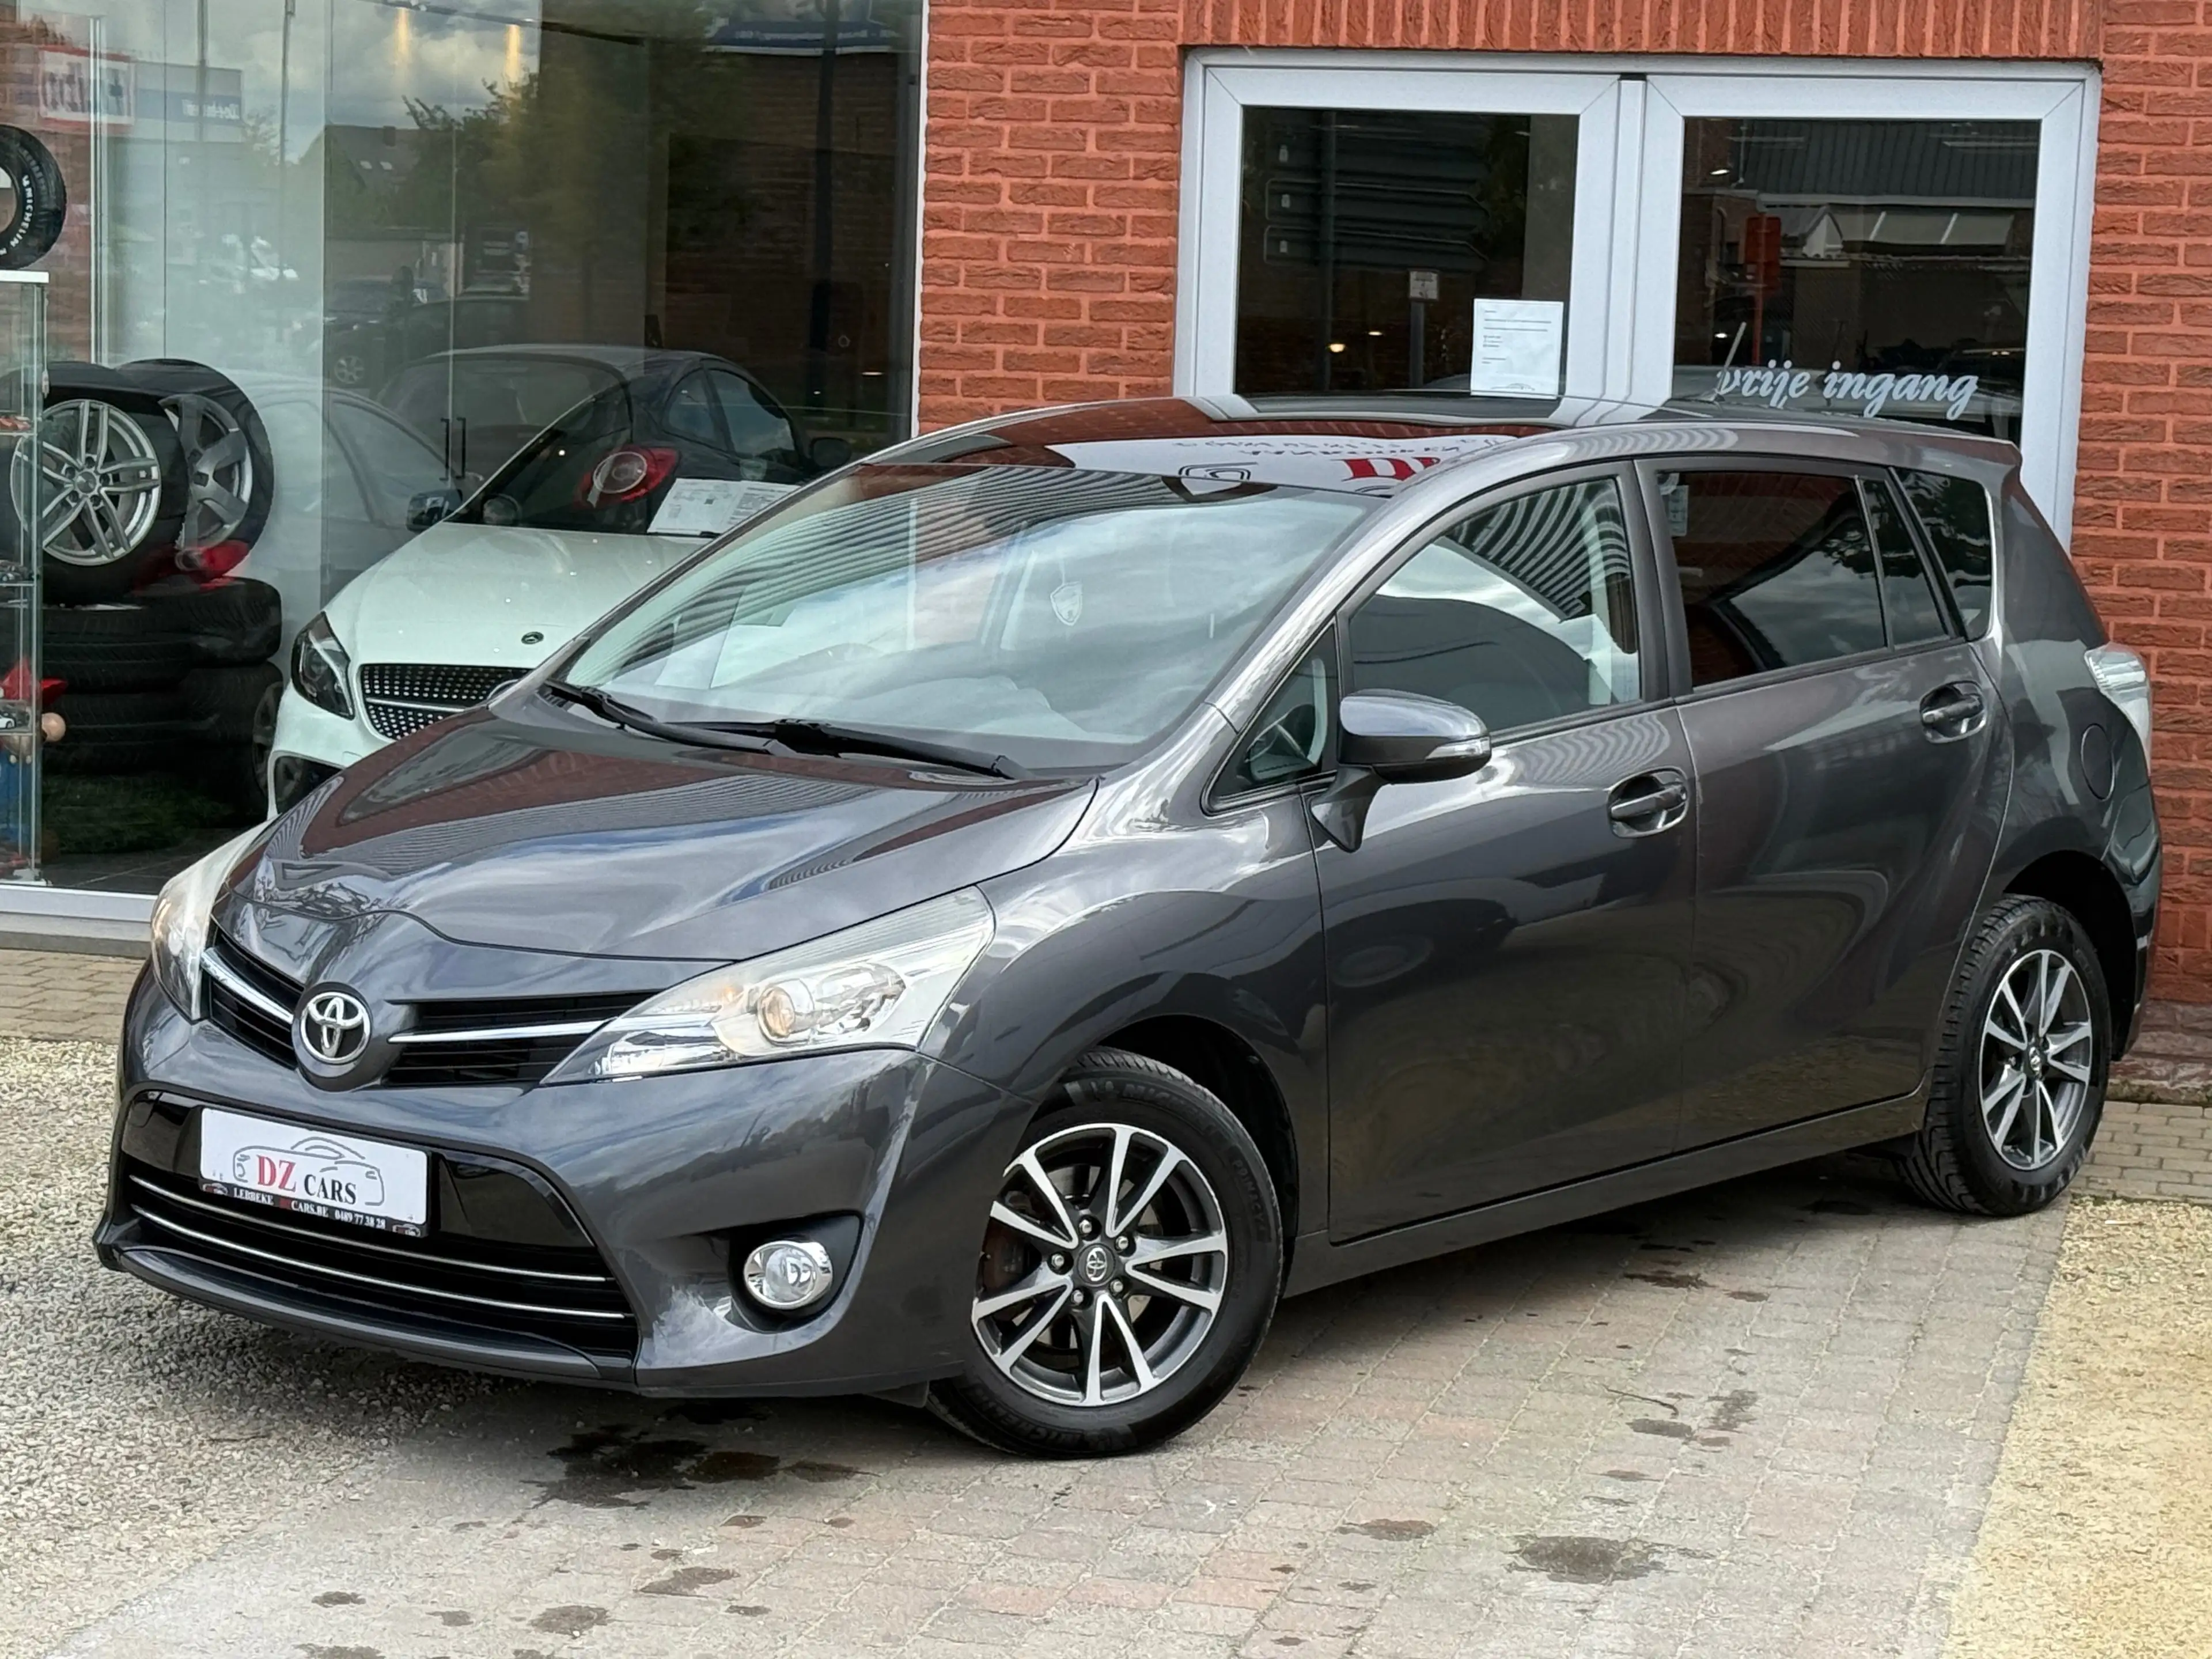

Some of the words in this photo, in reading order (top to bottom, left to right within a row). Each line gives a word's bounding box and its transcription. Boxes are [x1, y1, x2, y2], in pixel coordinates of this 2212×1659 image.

[9, 187, 33, 247] MICHELIN
[1717, 359, 1811, 408] vrije
[1824, 361, 1979, 421] ingang
[233, 1187, 274, 1205] LEBBEKE
[256, 1154, 297, 1192] DZ
[304, 1174, 357, 1205] CARS
